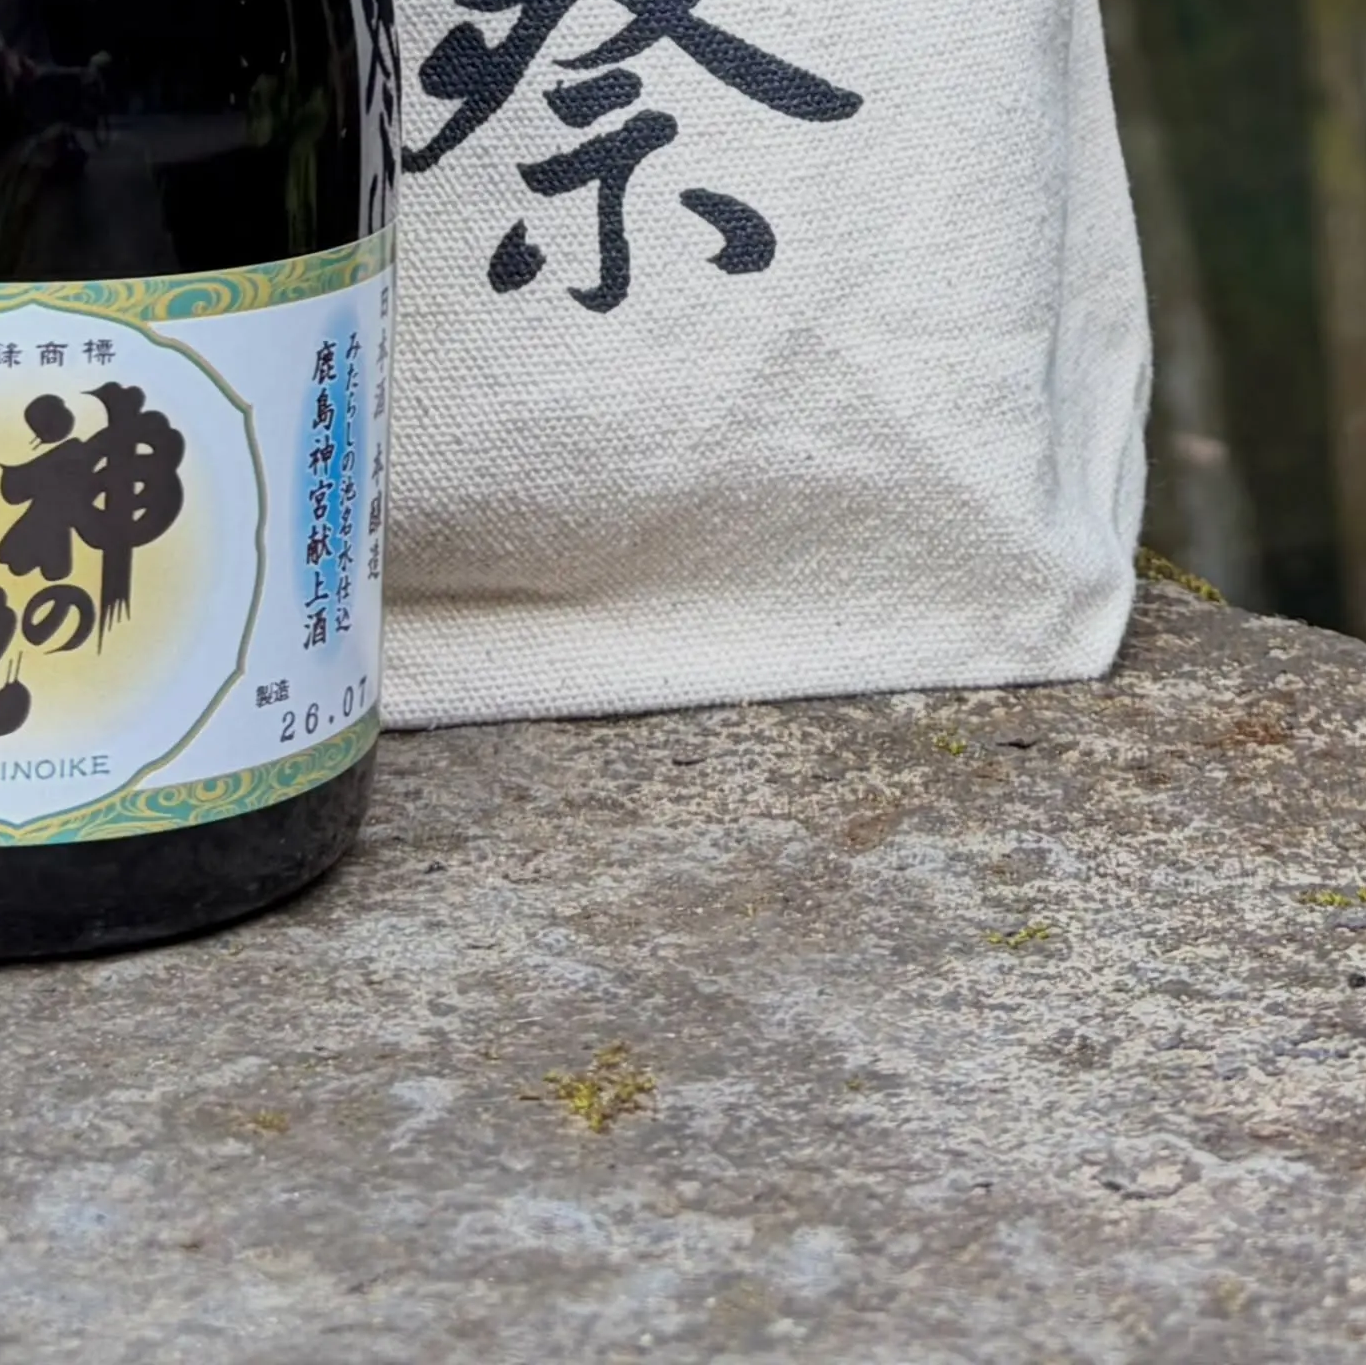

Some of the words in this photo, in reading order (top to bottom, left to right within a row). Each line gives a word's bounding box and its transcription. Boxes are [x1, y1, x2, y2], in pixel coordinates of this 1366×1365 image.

[303, 340, 337, 651] 鹿島神宮献上酒
[335, 331, 362, 633] みたらしの池名水仕込
[255, 679, 290, 709] 製造
[280, 675, 367, 743] 26.07
